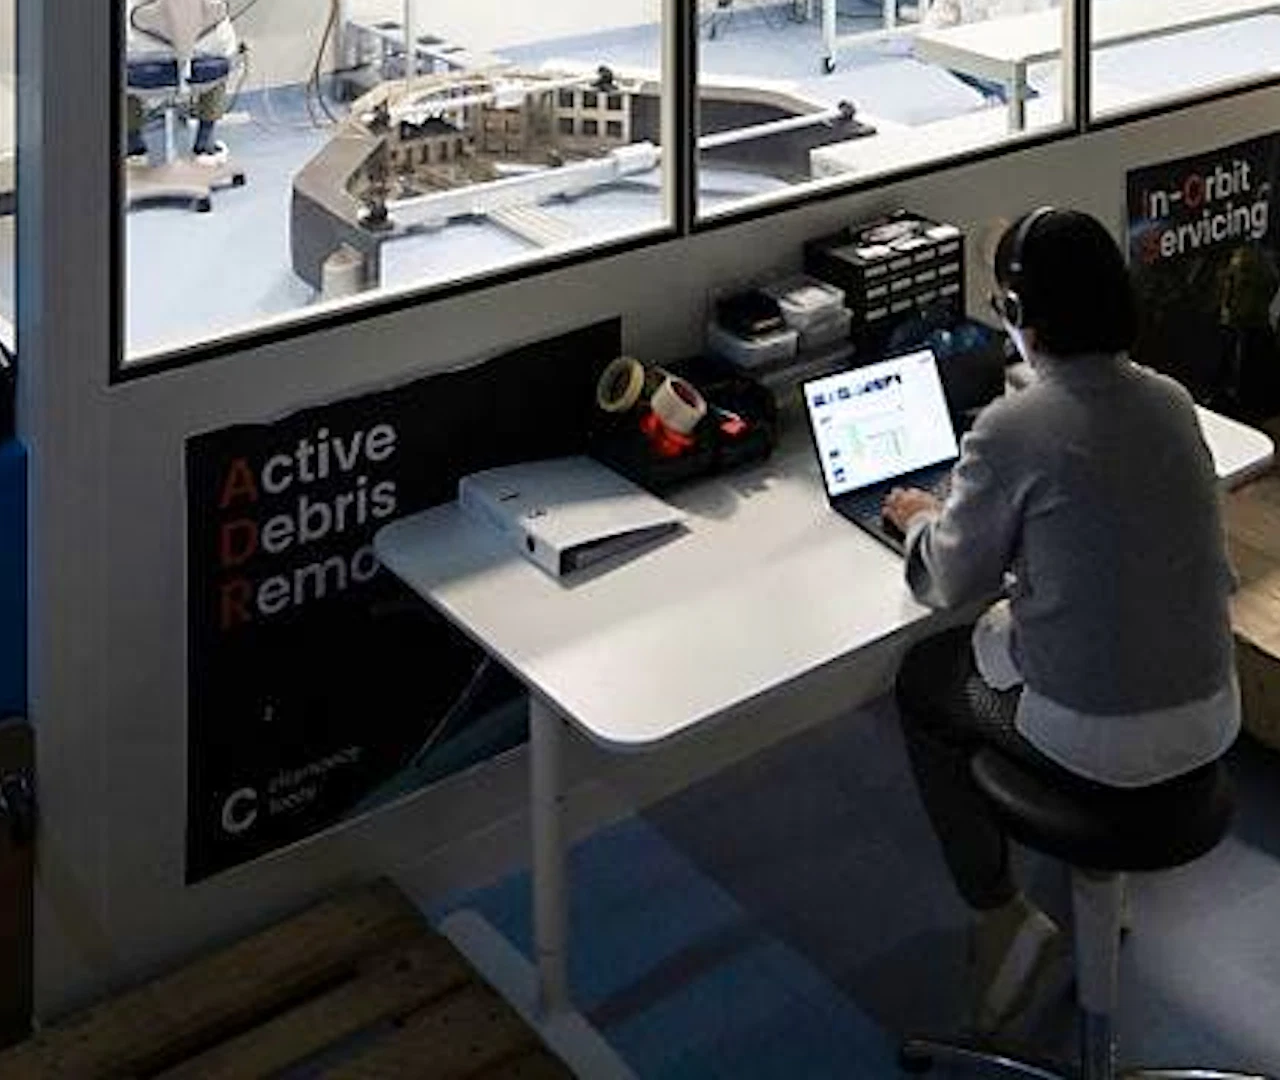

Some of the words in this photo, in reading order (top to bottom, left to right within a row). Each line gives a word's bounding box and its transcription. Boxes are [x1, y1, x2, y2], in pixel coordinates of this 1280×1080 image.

[218, 423, 397, 509] Active
[221, 475, 397, 566] Debris
[220, 544, 381, 628] Remo
